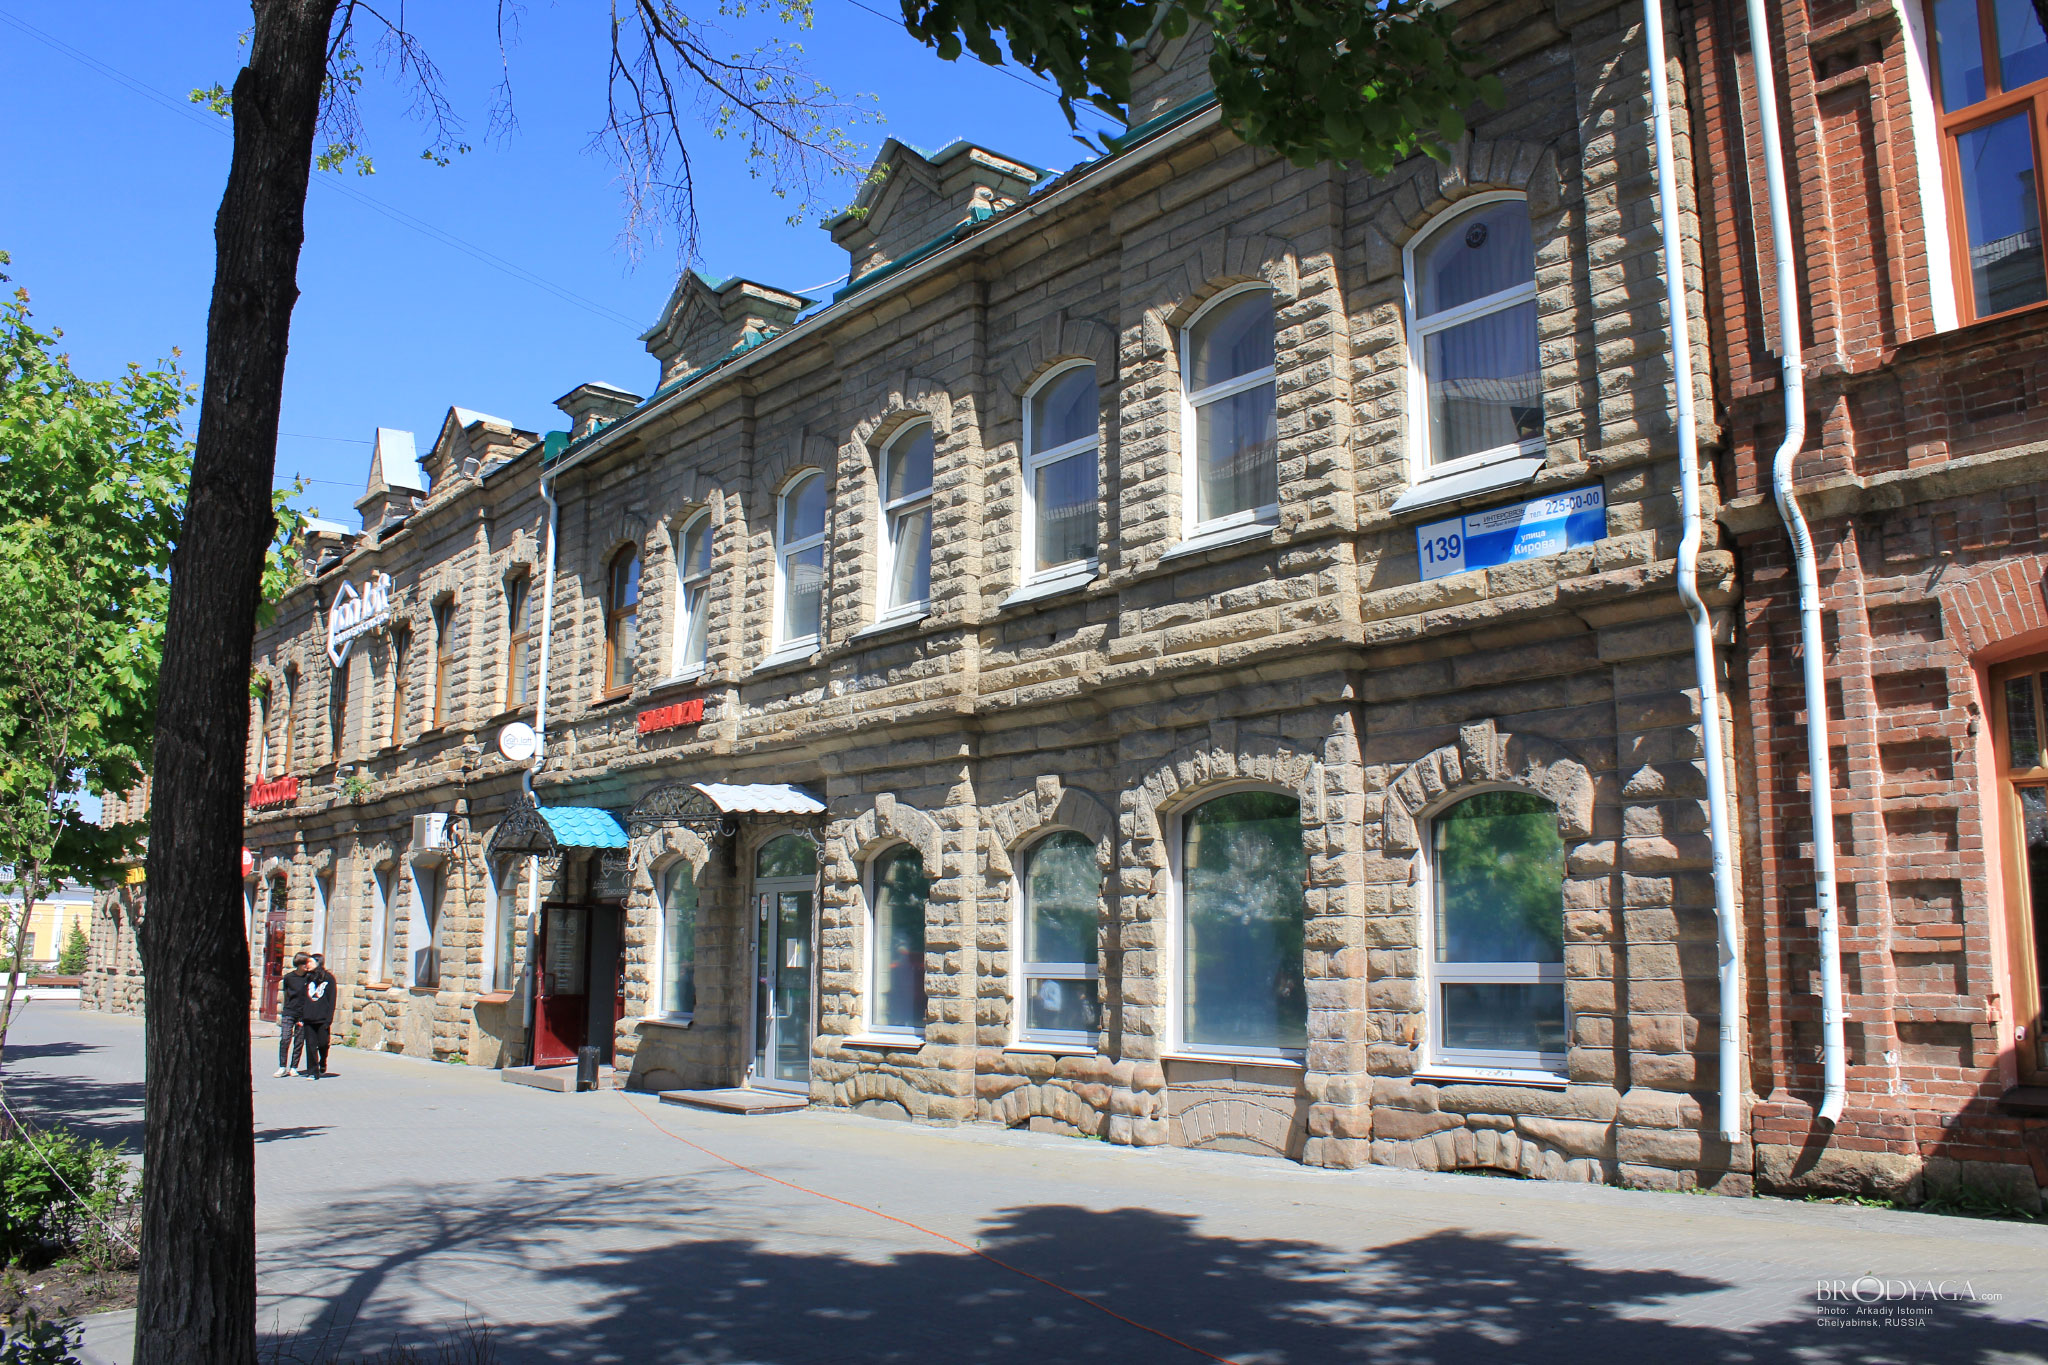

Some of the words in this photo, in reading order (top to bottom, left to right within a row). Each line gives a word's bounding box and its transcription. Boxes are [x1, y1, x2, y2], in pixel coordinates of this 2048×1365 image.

[1483, 508, 1525, 523] ИНТЕРСВЯЗЬ
[1545, 491, 1600, 515] 225-00-00
[1423, 533, 1461, 564] 139
[1514, 538, 1556, 555] Кирова
[1520, 530, 1546, 543] улица
[637, 698, 704, 734] SOBLAZN
